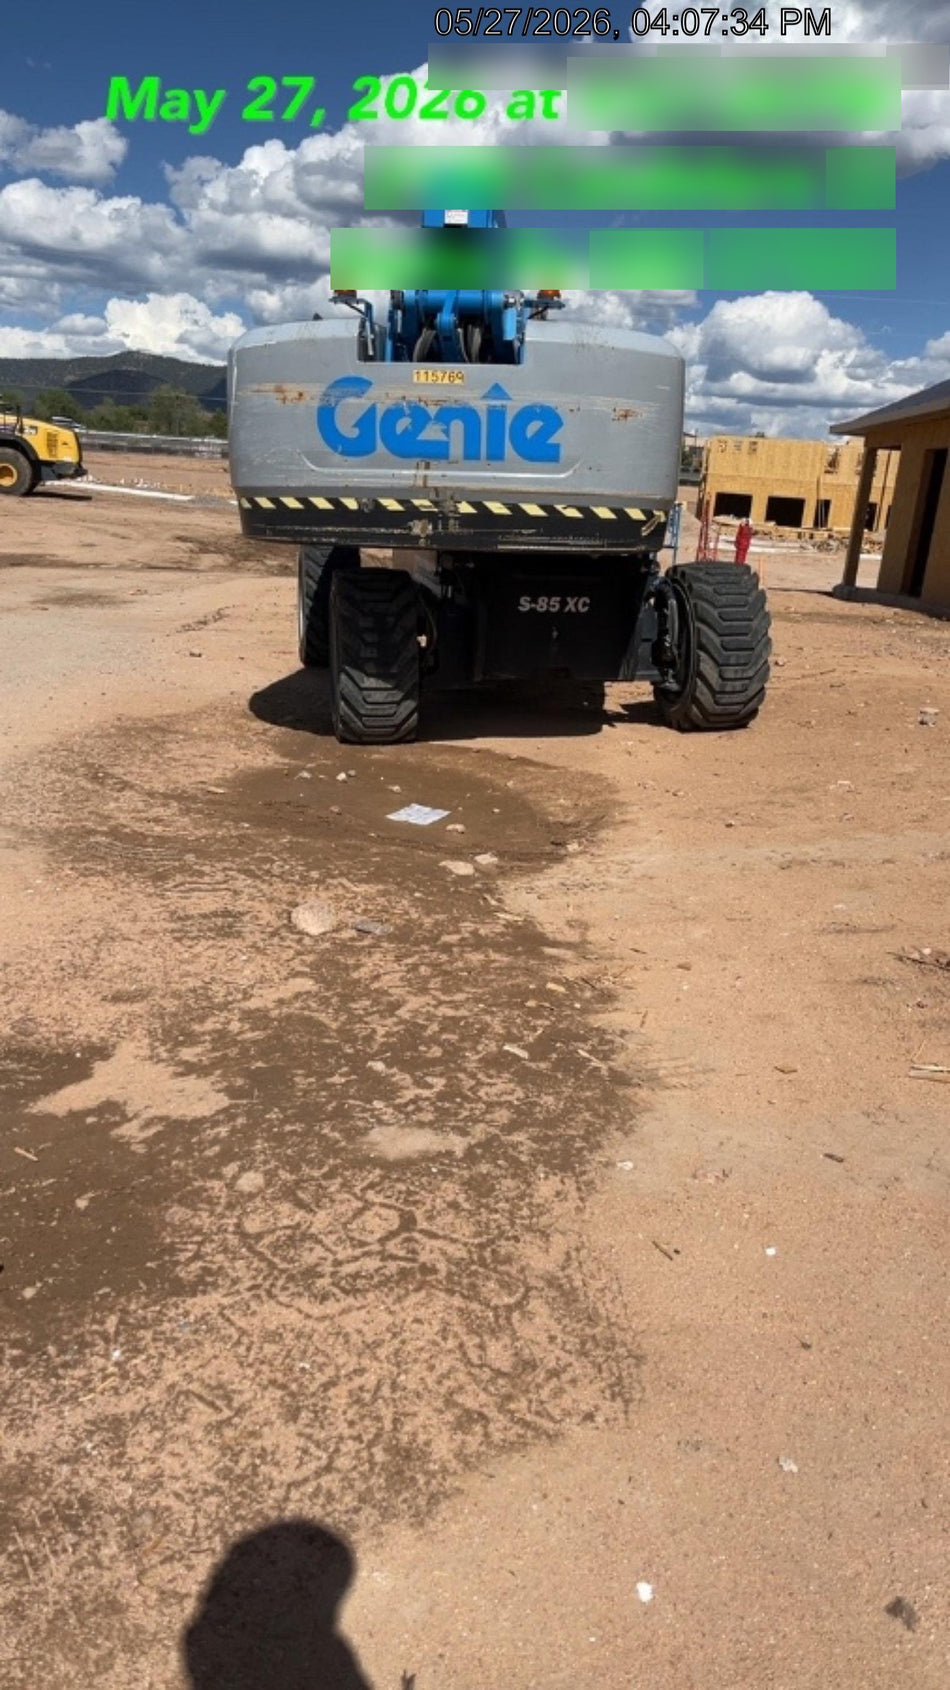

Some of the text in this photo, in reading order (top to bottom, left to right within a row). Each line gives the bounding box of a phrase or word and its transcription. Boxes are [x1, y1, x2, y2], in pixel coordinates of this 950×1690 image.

[415, 370, 465, 384] 115769
[316, 375, 564, 463] Genie
[517, 595, 591, 613] S-85 XC
